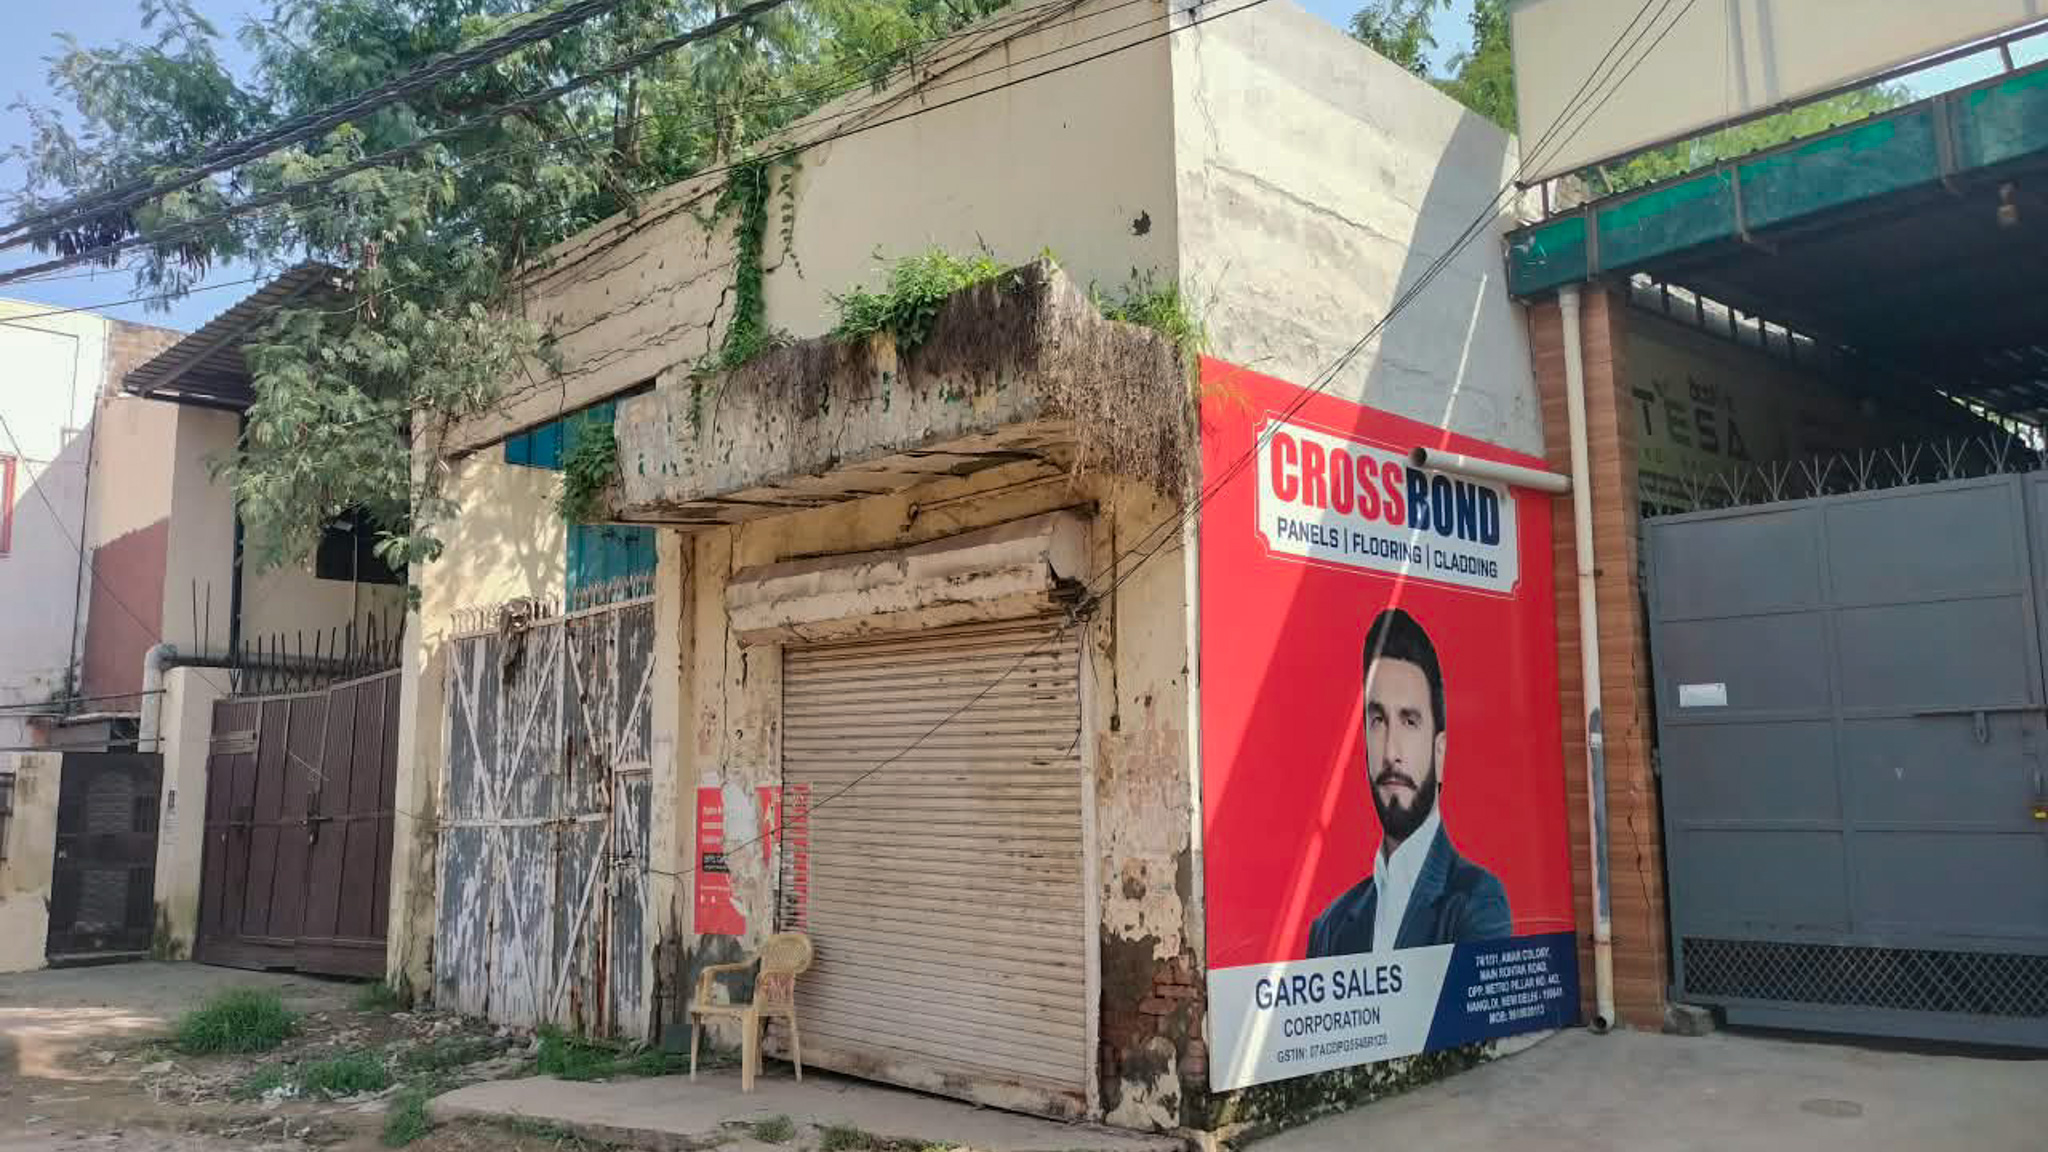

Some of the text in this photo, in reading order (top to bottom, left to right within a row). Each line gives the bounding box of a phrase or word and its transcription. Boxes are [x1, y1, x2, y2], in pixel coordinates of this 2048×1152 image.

[1270, 431, 1500, 546] CROSSBOND
[1277, 516, 1498, 578] PANELS FLOORING CLADDING
[1255, 964, 1403, 1010] GARG SALES
[1501, 995, 1517, 1007] NEW
[1284, 1007, 1381, 1038] CORPORATION
